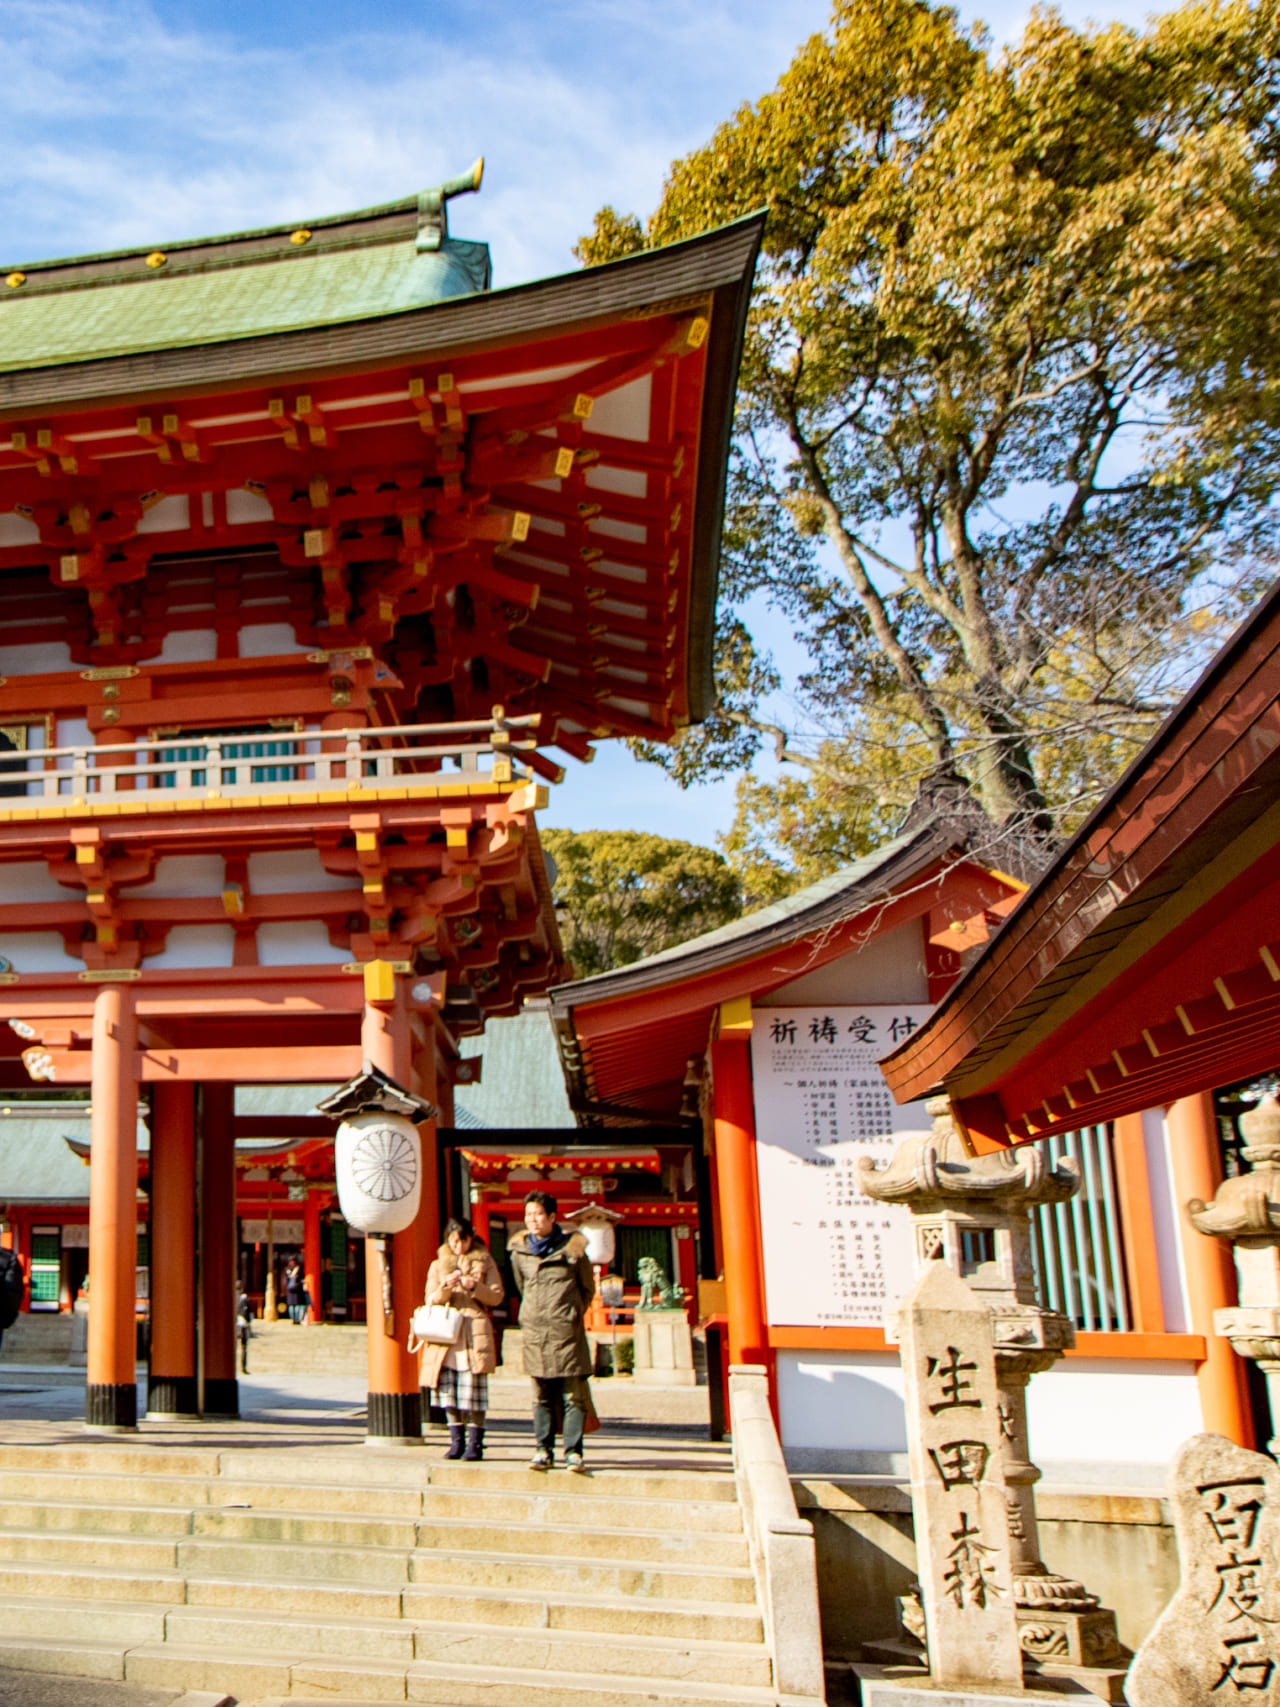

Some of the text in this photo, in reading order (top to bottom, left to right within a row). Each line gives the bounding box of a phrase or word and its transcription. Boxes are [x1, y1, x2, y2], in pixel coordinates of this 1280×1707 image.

[927, 1346, 1008, 1610] 生田森
[1195, 1476, 1280, 1692] 百度石
